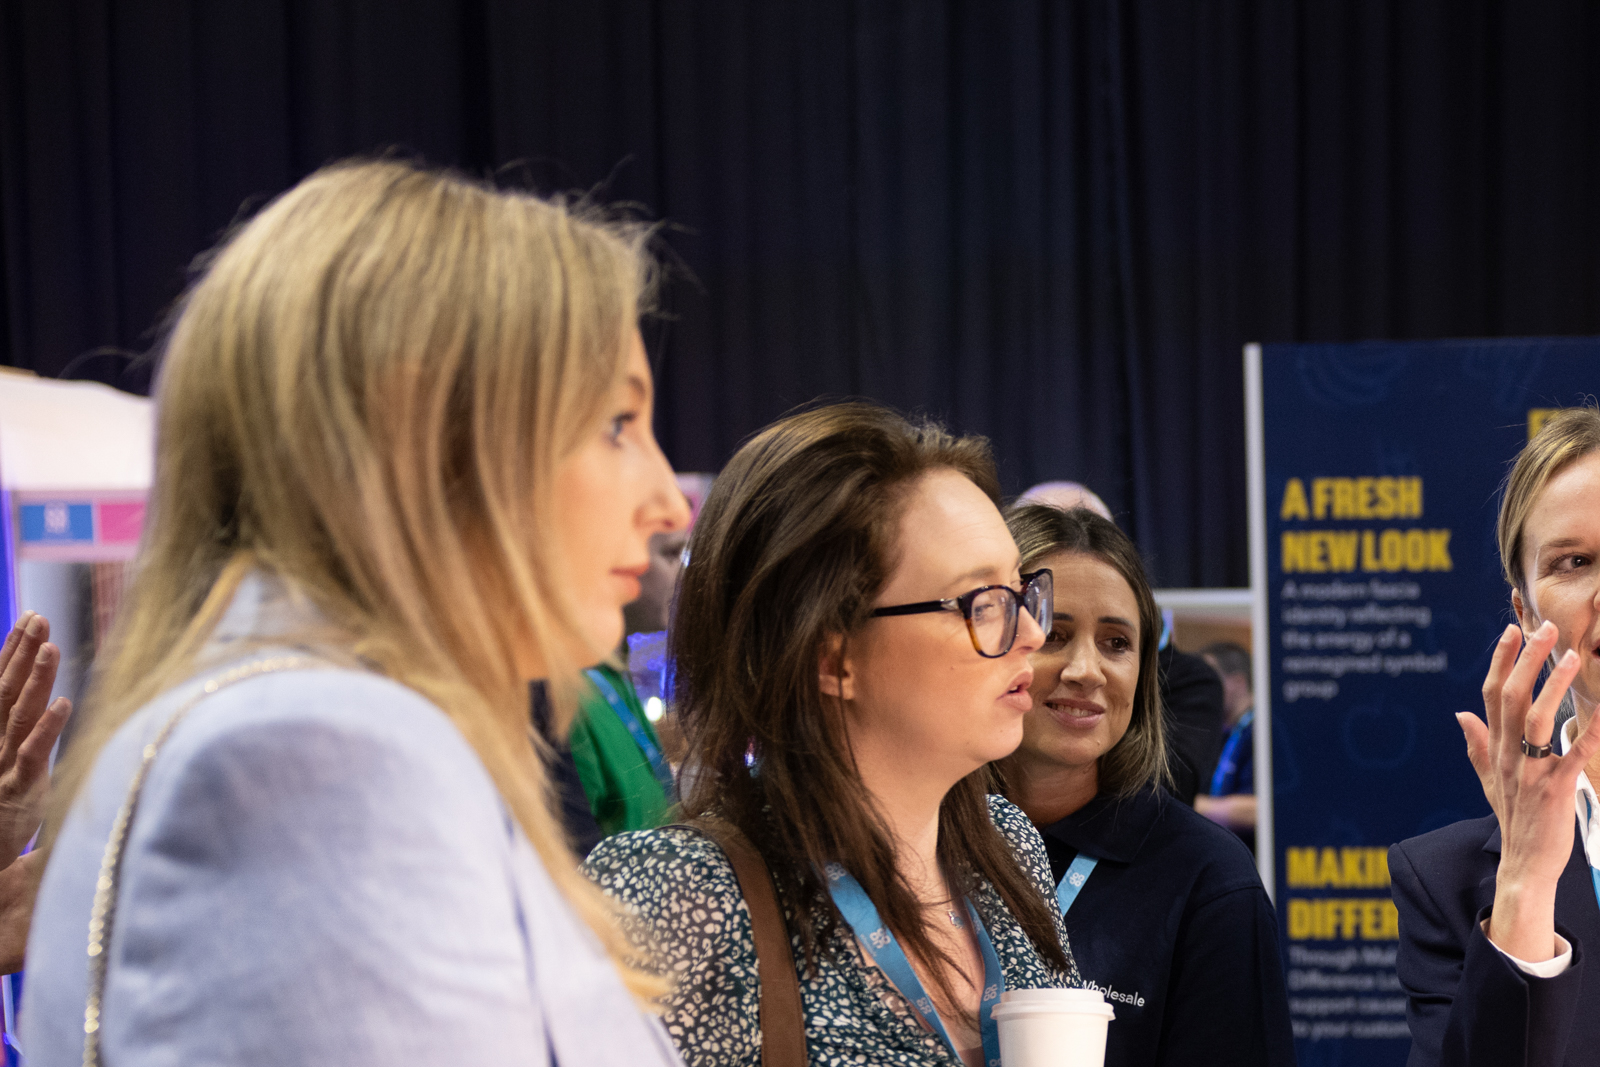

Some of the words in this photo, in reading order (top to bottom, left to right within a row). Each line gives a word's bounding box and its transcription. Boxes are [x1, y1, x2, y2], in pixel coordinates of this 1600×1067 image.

[1280, 477, 1309, 521] A
[1310, 475, 1423, 520] FRESH
[1281, 529, 1358, 573] NEW
[1360, 528, 1453, 572] LOOK
